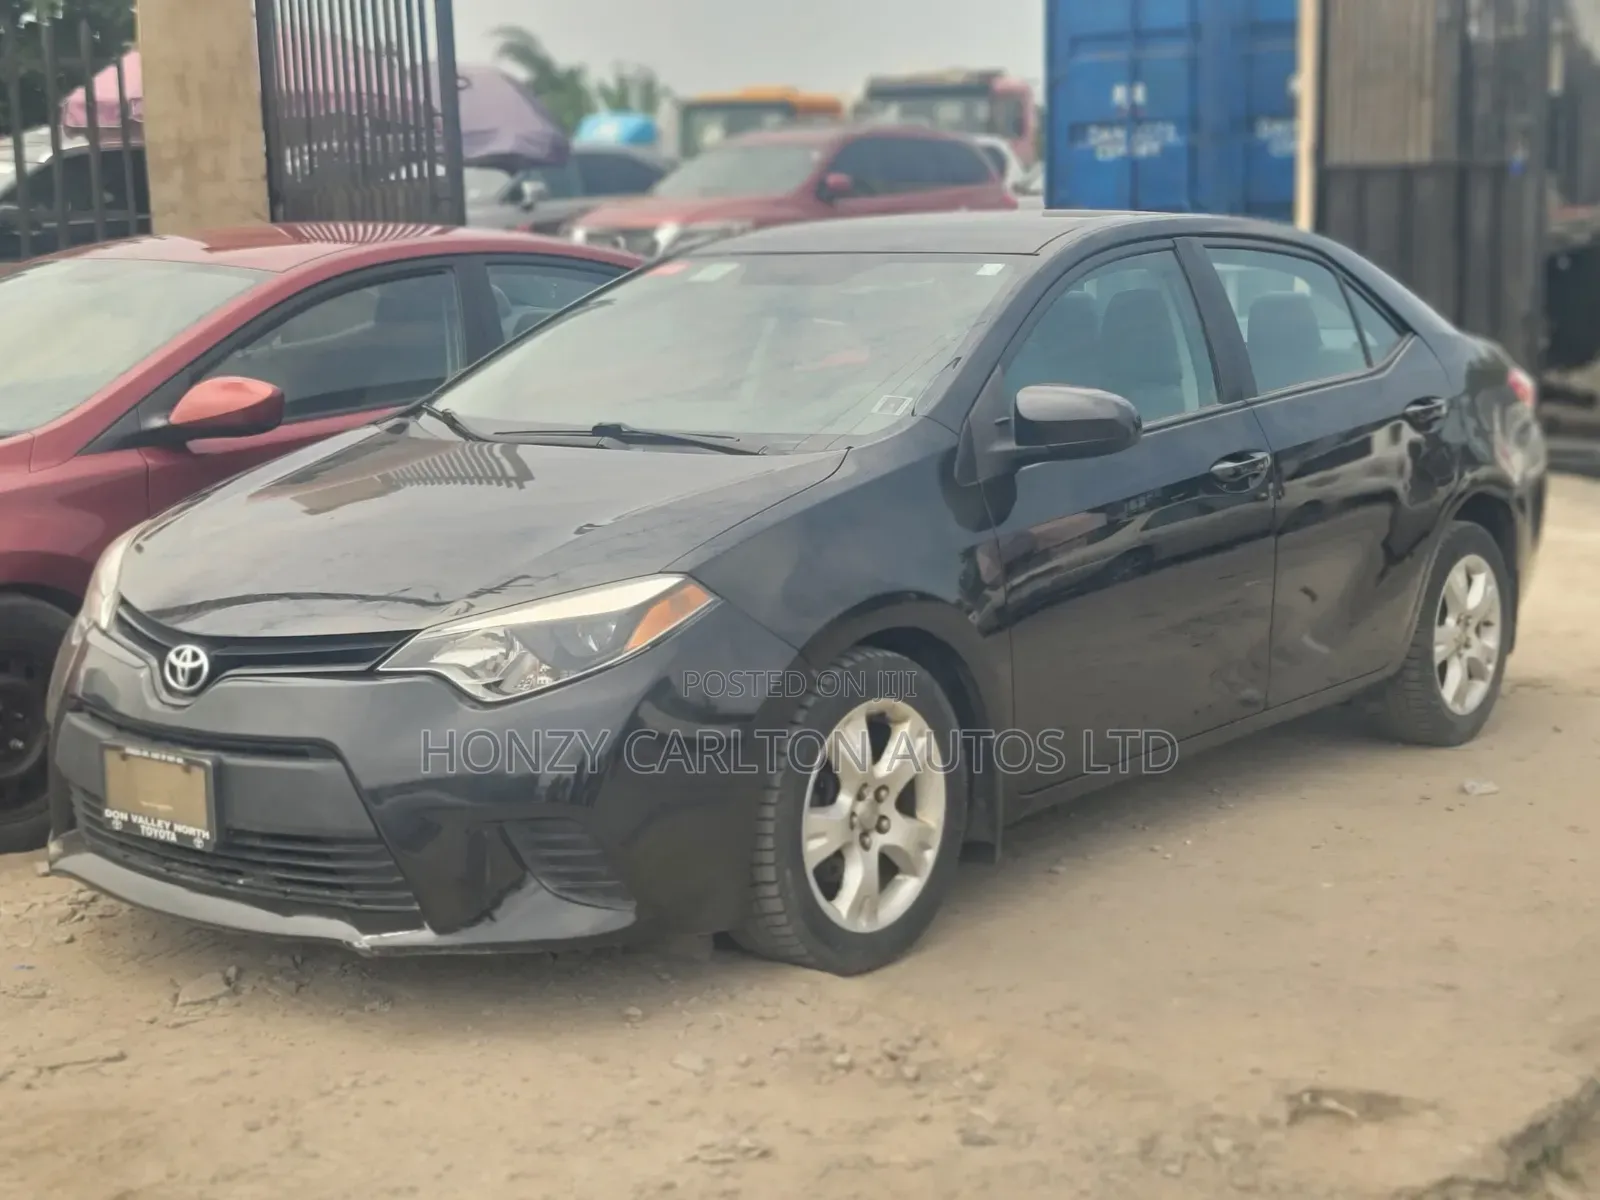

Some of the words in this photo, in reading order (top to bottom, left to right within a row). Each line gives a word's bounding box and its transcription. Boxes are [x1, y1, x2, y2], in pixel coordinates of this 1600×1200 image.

[131, 814, 172, 830] VALLEY
[173, 823, 210, 840] NORTH
[140, 825, 177, 842] TOYOTA
